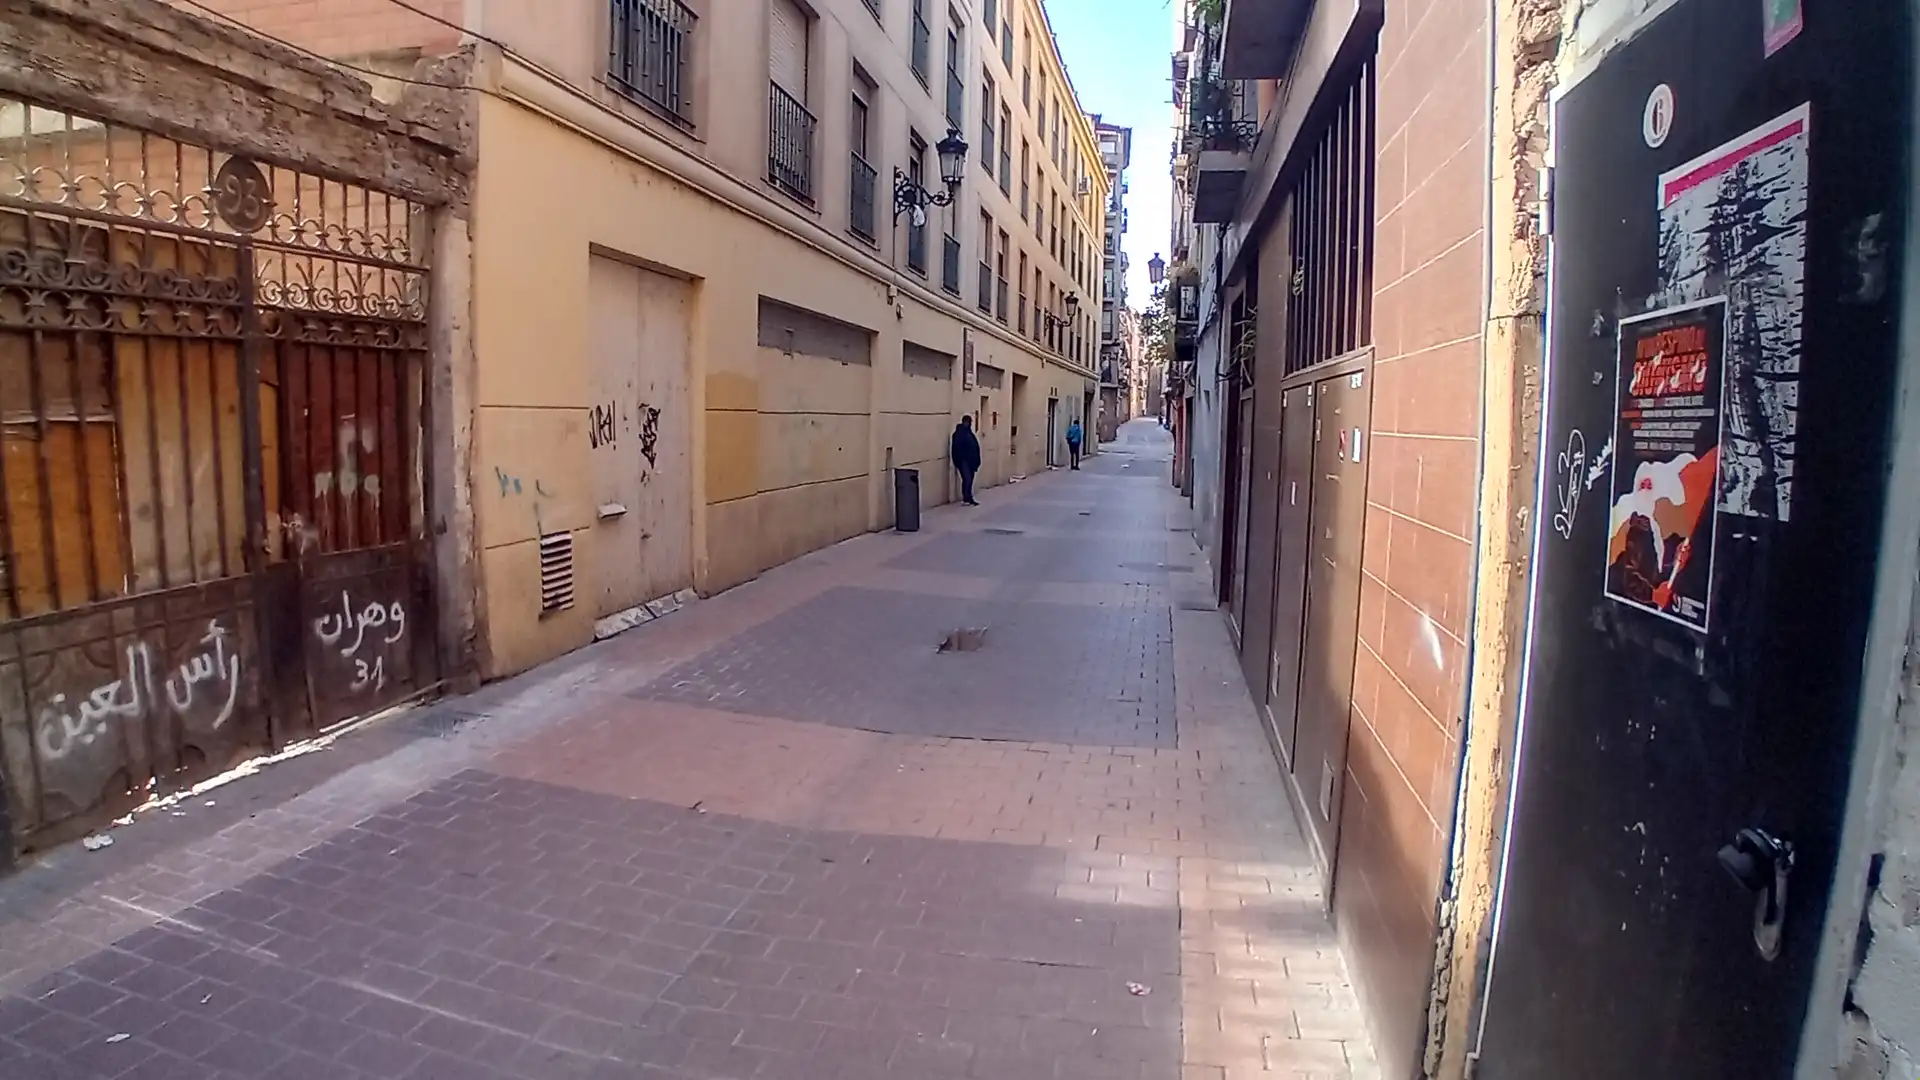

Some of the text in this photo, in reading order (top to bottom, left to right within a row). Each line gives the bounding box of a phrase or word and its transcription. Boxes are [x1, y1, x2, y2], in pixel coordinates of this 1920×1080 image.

[315, 589, 405, 658] وهران
[36, 617, 239, 758] رأس العين
[349, 655, 386, 693] 31
